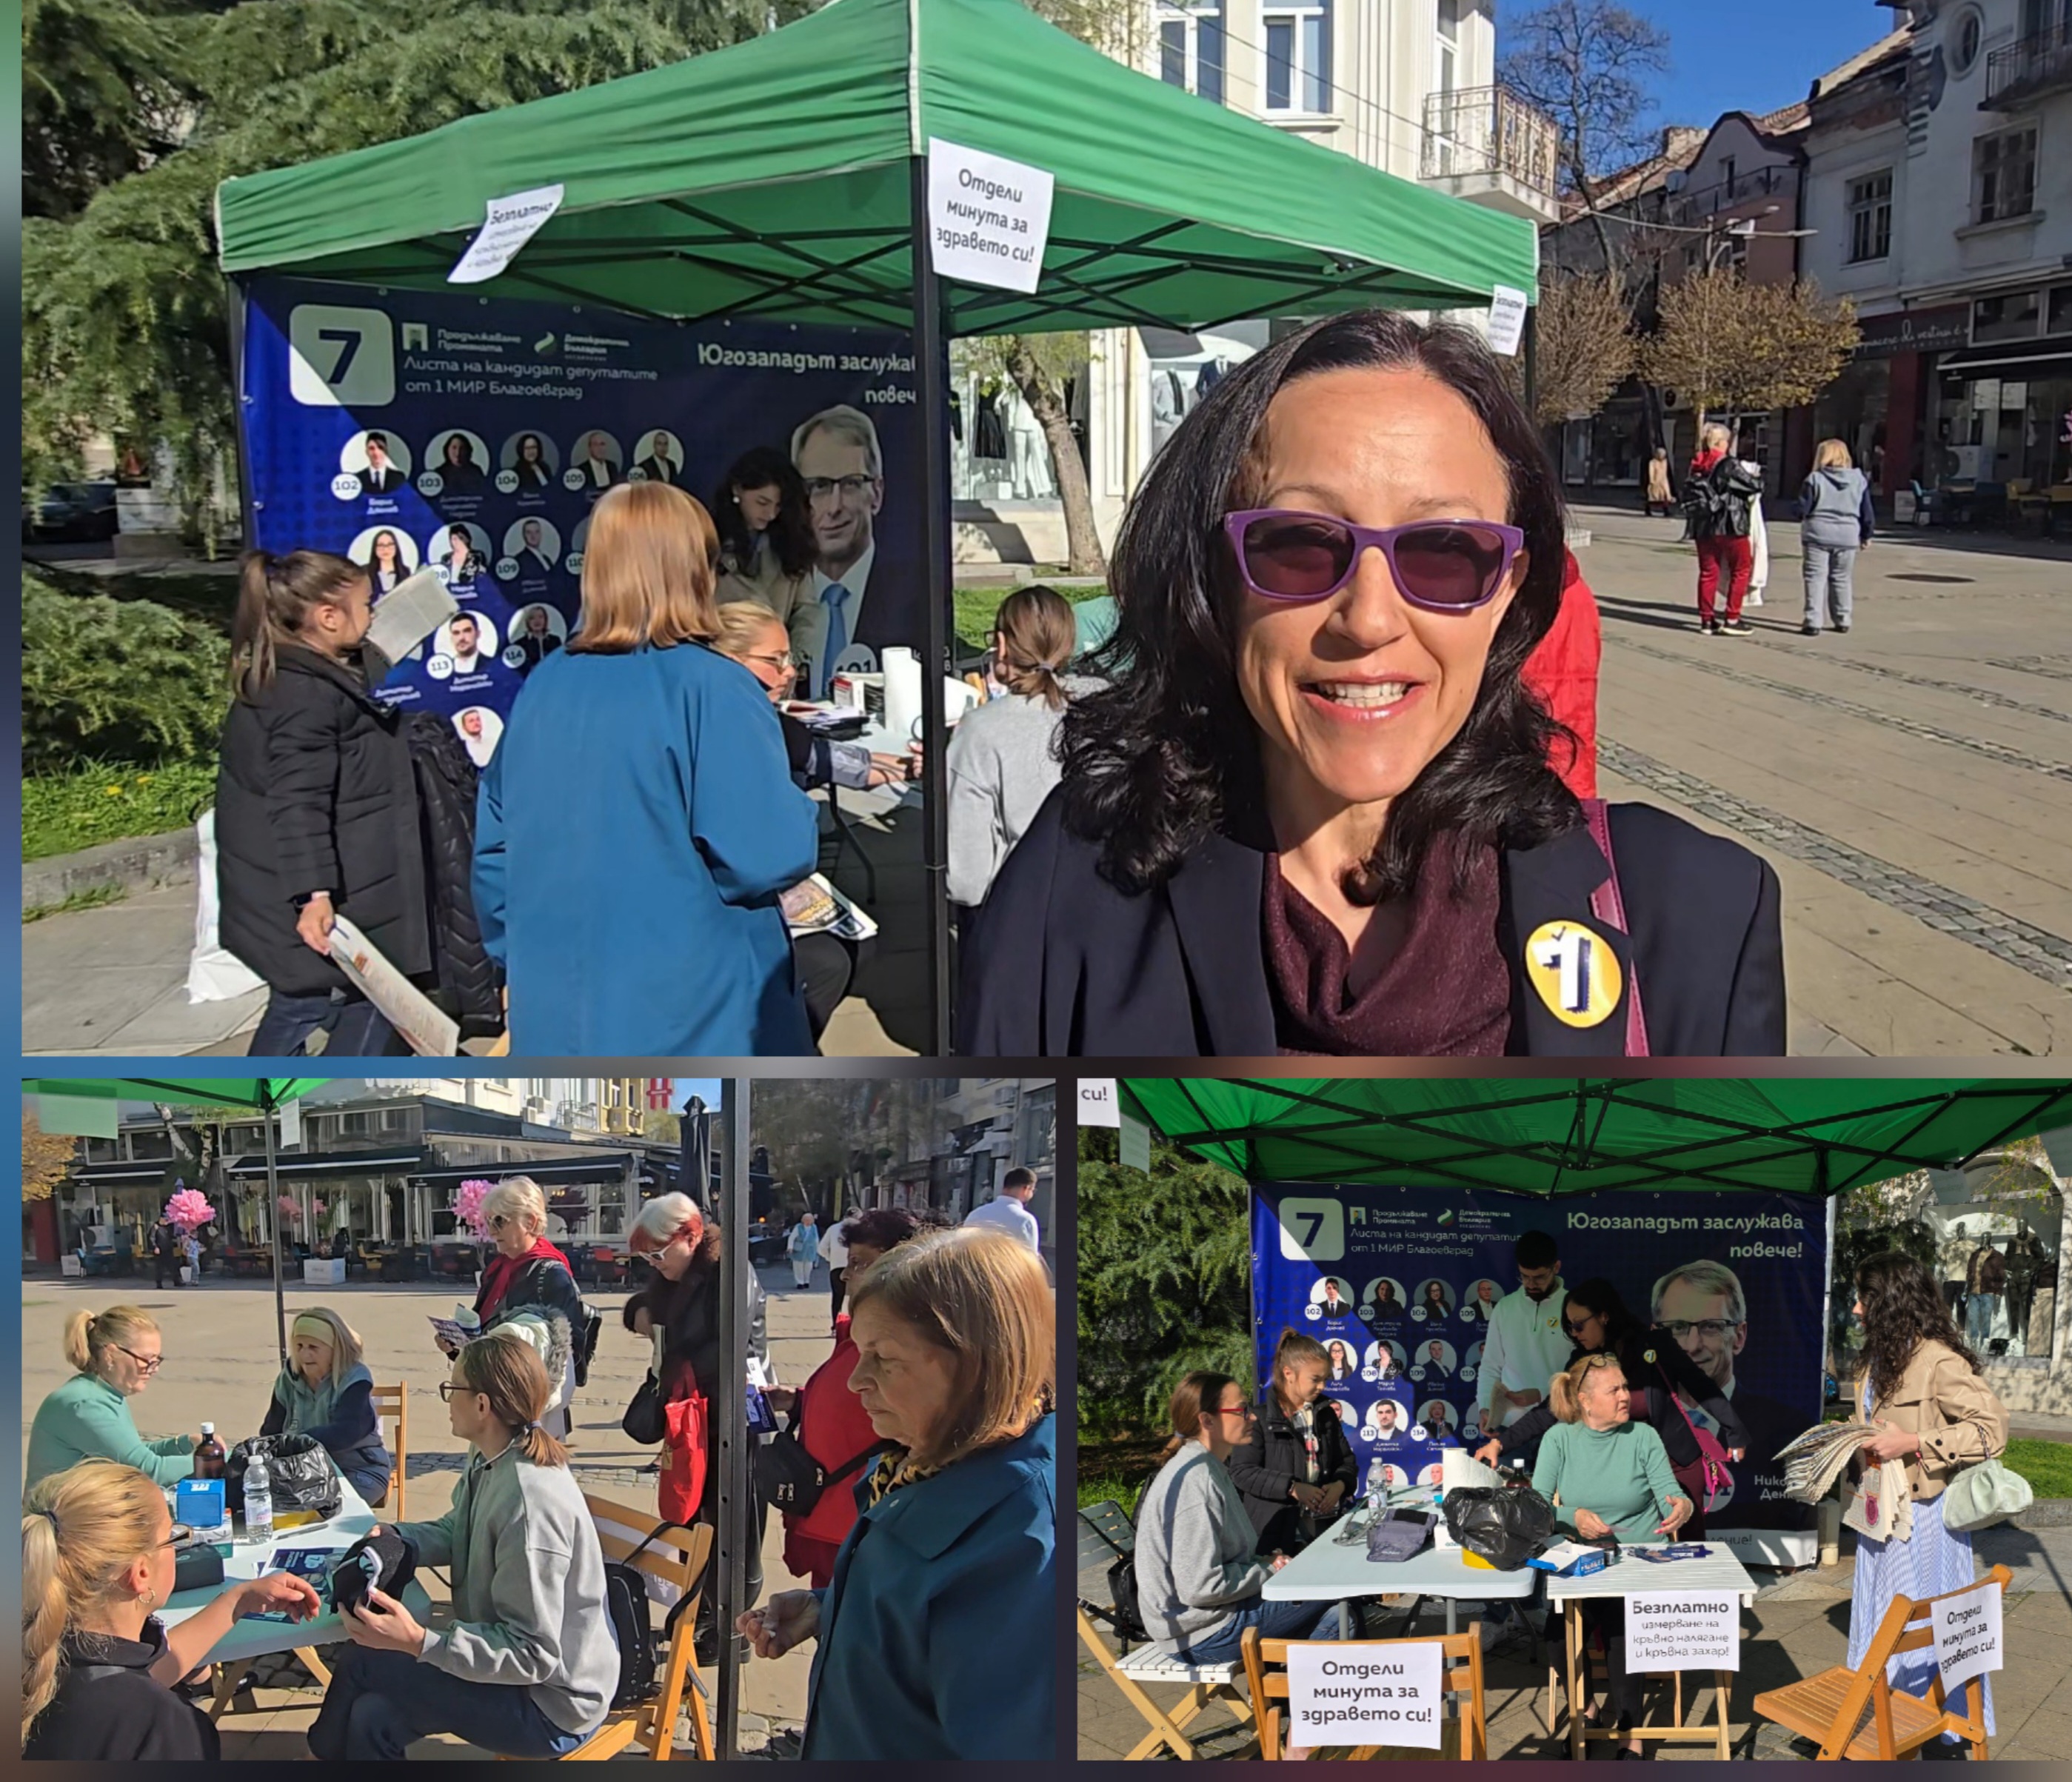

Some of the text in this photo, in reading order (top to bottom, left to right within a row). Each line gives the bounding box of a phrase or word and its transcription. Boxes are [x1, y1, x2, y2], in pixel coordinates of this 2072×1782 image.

[958, 168, 1023, 203] Отдели
[946, 200, 1028, 233] минута за
[936, 227, 1035, 263] здравето си!
[318, 329, 361, 384] 7
[698, 343, 916, 376] Югозападът заслужа
[404, 356, 658, 381] Листа на кандидат депутатите
[405, 379, 583, 400] от 1 МИР Благоевград
[866, 384, 916, 404] повеч
[335, 481, 358, 490] 102
[420, 478, 441, 488] 103
[498, 475, 517, 485] 104
[566, 475, 583, 483] 105
[498, 564, 517, 573] 109
[505, 650, 522, 660] 114
[431, 661, 450, 671] 113
[1081, 1086, 1108, 1101] си!
[1296, 1212, 1324, 1247] 7
[1567, 1212, 1804, 1233] Югозападът заслужава
[1350, 1228, 1386, 1238] Листа
[1405, 1229, 1458, 1242] кандидат
[1371, 1244, 1376, 1252] 1
[1378, 1244, 1404, 1252] МИР
[1407, 1244, 1474, 1256] Благоевград
[1730, 1241, 1802, 1258] повече!
[1754, 1475, 1788, 1486] Нико
[1633, 1601, 1729, 1614] Безплатно
[1947, 1605, 1982, 1625] Отдели
[1642, 1619, 1720, 1630] измерване на
[1634, 1634, 1729, 1646] кръвно налягане
[1942, 1623, 1988, 1648] минута за
[1645, 1646, 1689, 1659] кръвна
[1692, 1646, 1730, 1658] захар!
[1941, 1637, 1995, 1673] здравето си!
[1322, 1661, 1403, 1679] Отдели
[1314, 1686, 1420, 1702] минута за
[1301, 1706, 1431, 1725] здравето си!
